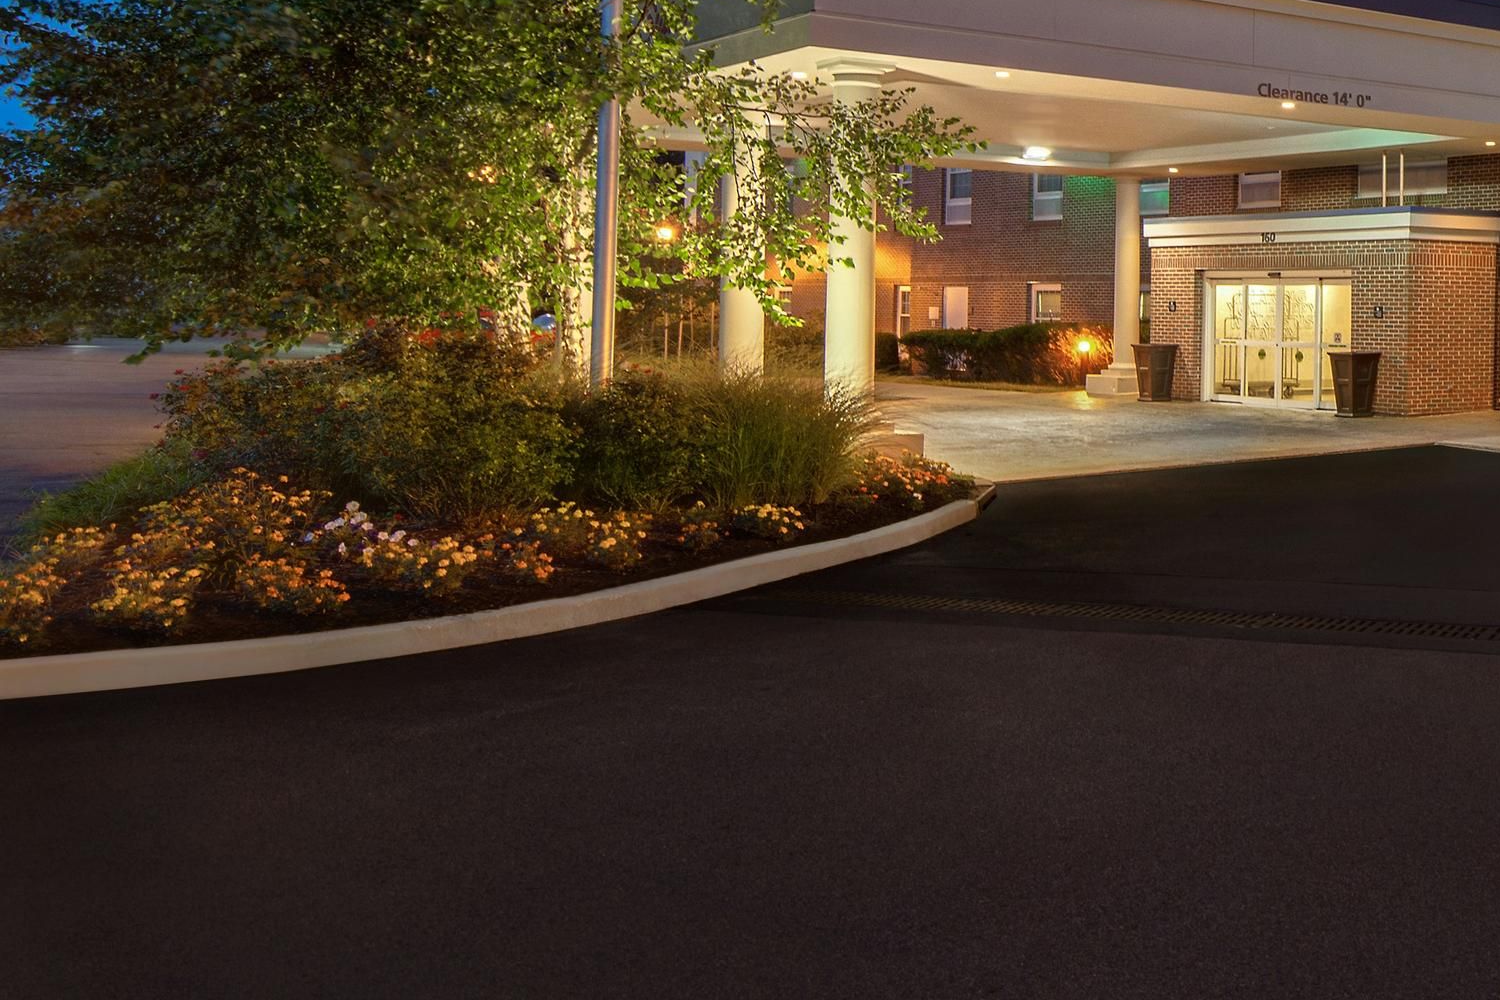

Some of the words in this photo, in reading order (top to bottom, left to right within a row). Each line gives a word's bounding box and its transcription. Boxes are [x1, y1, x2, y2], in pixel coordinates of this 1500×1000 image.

[1257, 83, 1329, 104] Clearance
[1332, 91, 1352, 106] 14'
[1356, 94, 1371, 108] 0"
